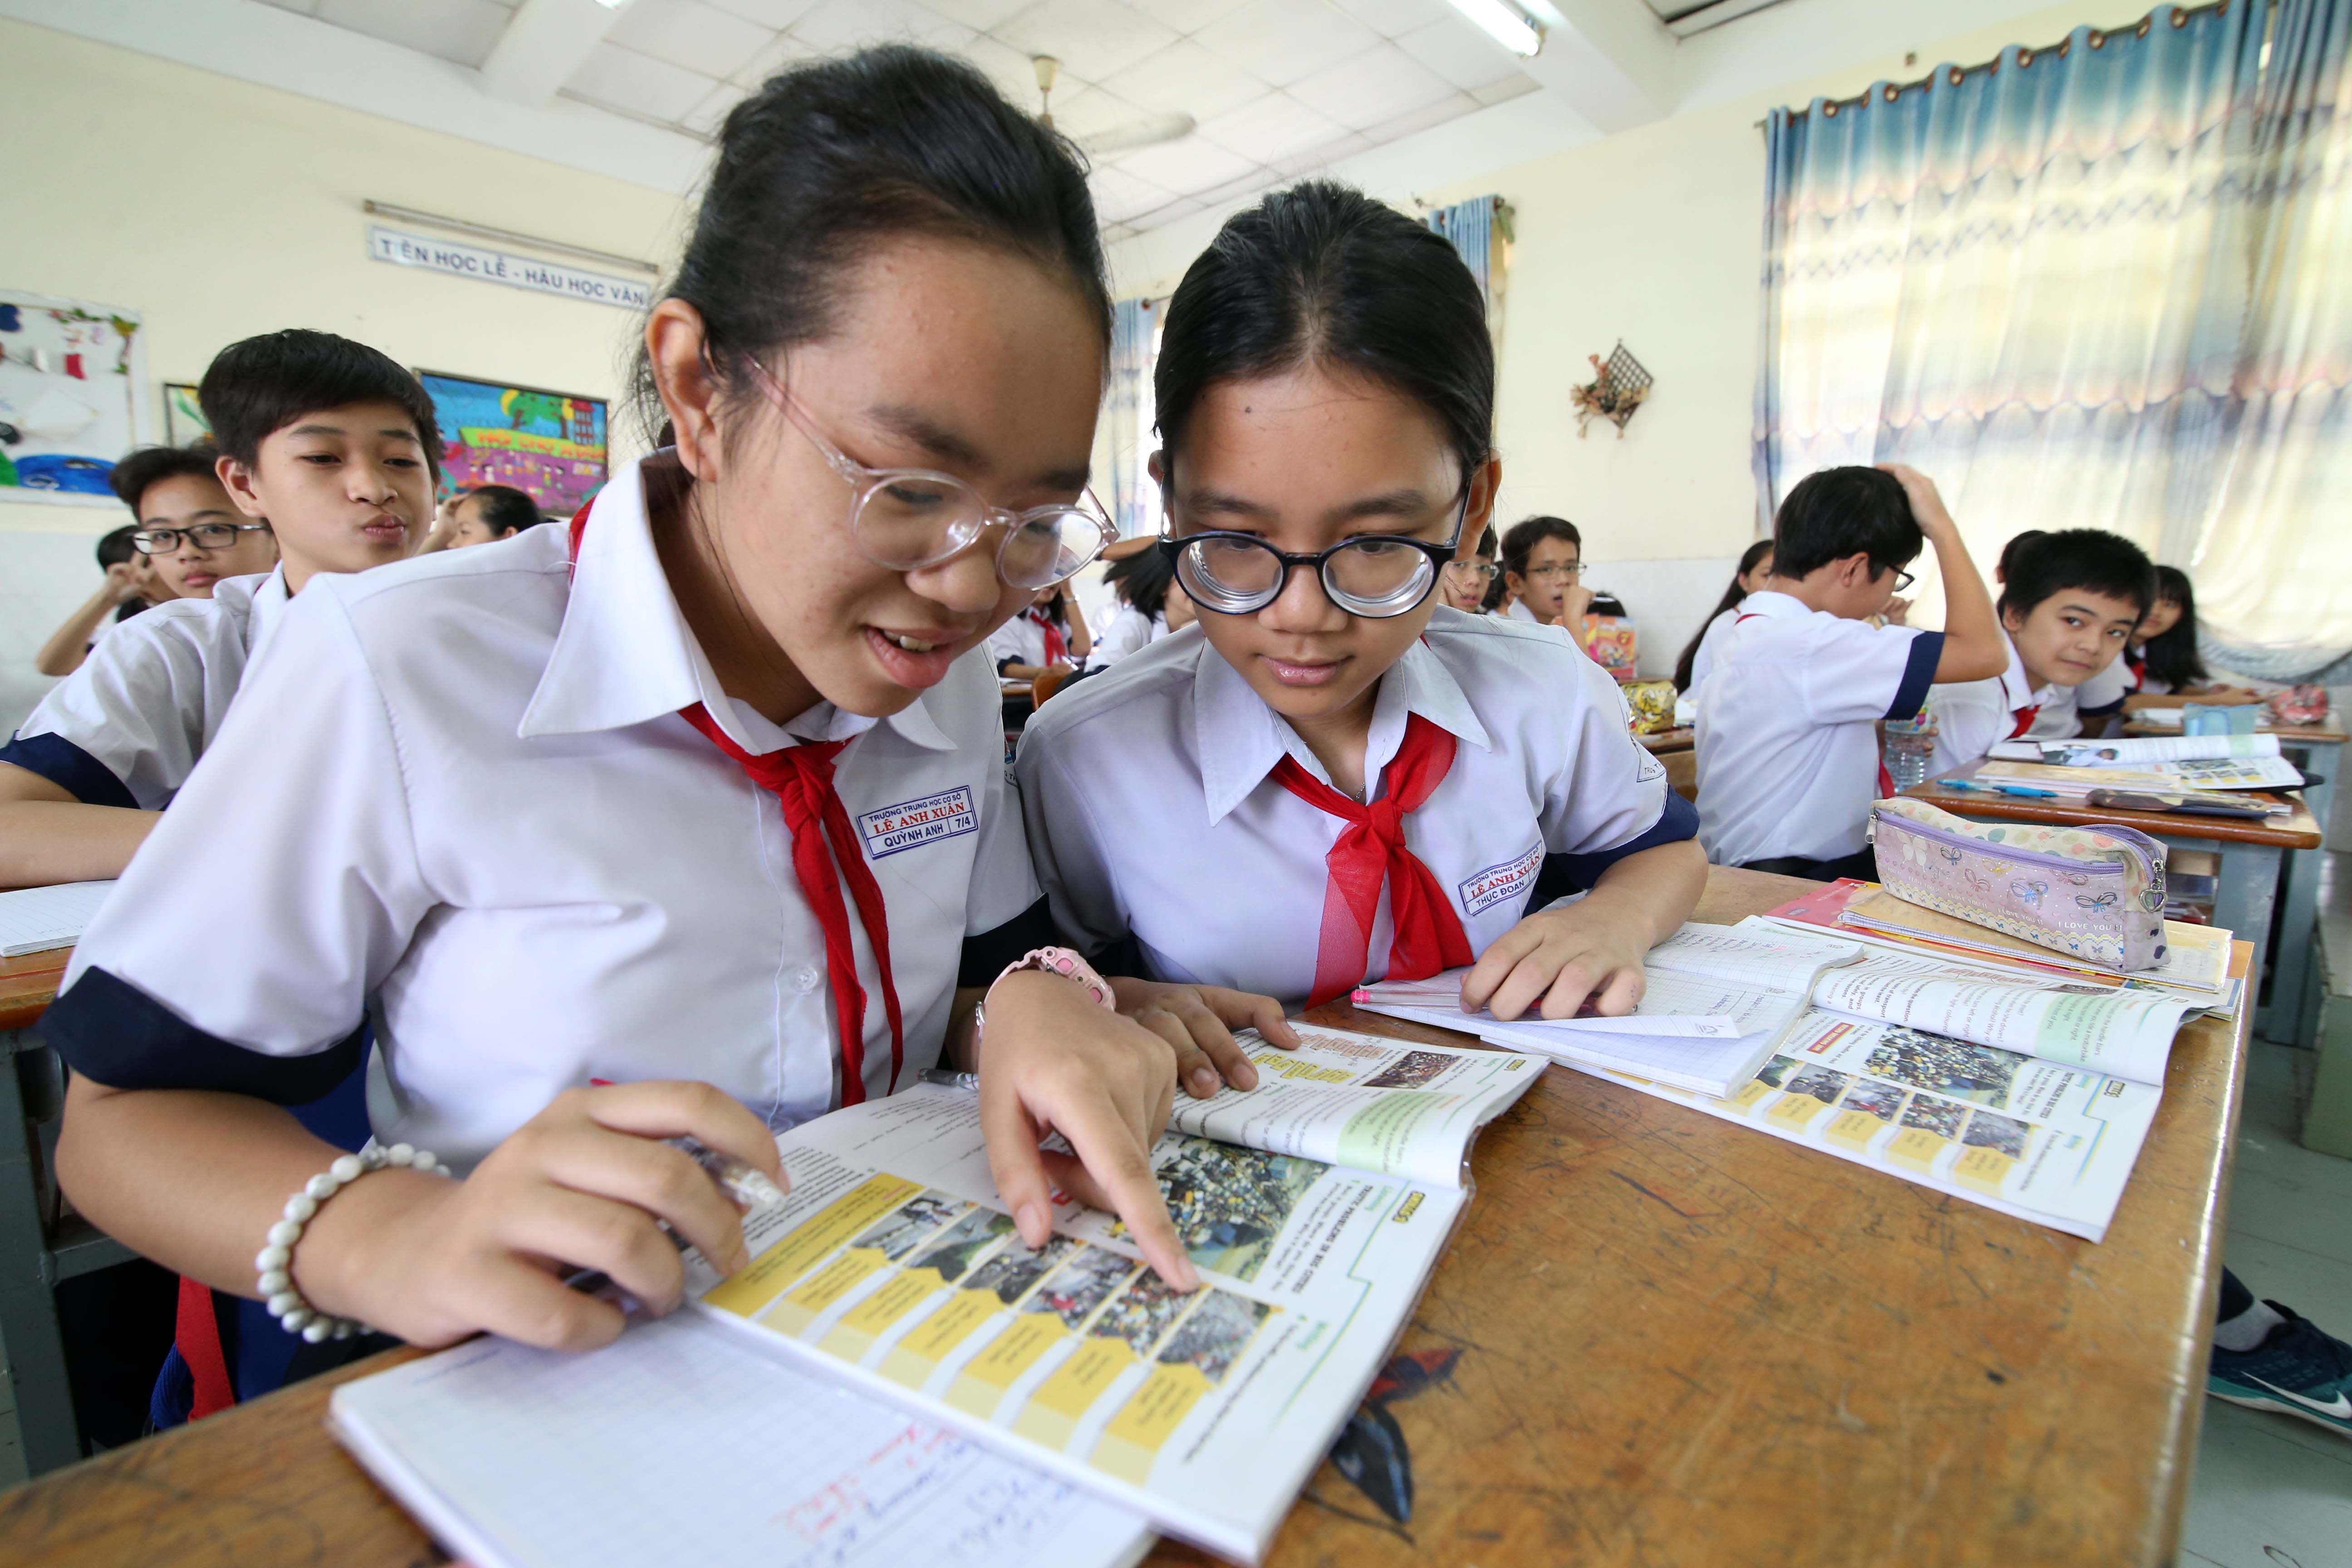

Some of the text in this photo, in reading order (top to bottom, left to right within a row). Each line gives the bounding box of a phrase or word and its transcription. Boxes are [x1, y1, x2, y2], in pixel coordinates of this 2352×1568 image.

[435, 250, 477, 273] HỌC
[569, 278, 605, 298] HỌC
[868, 808, 902, 823] TRƯỜNG
[903, 802, 928, 813] TRUNG
[929, 799, 941, 807] HỌC
[952, 791, 961, 801] SỞ
[873, 802, 965, 834] LÊ ANH XUÂN
[955, 815, 970, 829] 7/4
[884, 823, 944, 848] QUỲNH ANH
[1467, 873, 1489, 889] TRƯỜNG
[1490, 866, 1513, 877] TRUNG
[1514, 860, 1525, 869] HỌC
[1526, 853, 1533, 861] CƠ
[1471, 853, 1541, 898] LÊ ANH XUÂN
[1476, 879, 1525, 907] THỤC ĐOAN
[2002, 909, 2019, 918] LOVE
[2021, 914, 2035, 923] YOU
[1841, 982, 1852, 999] reasons.
[1850, 984, 1861, 997] safely,
[1874, 991, 1883, 1004] least.
[1855, 991, 1865, 1011] groups,
[1879, 994, 1891, 1017] transport
[1902, 999, 1914, 1023] question.
[1942, 1009, 1953, 1032] coloured
[1968, 1008, 1977, 1016] left
[1961, 1024, 1971, 1037] right
[1984, 1022, 1994, 1036] Why
[1996, 1023, 2007, 1042] drives?
[2097, 1025, 2108, 1042] handle
[1325, 1205, 1355, 1245] PROBLEMS
[1318, 1242, 1331, 1254] IN
[1308, 1252, 1325, 1270] BIG
[1291, 1267, 1314, 1296] CITIES
